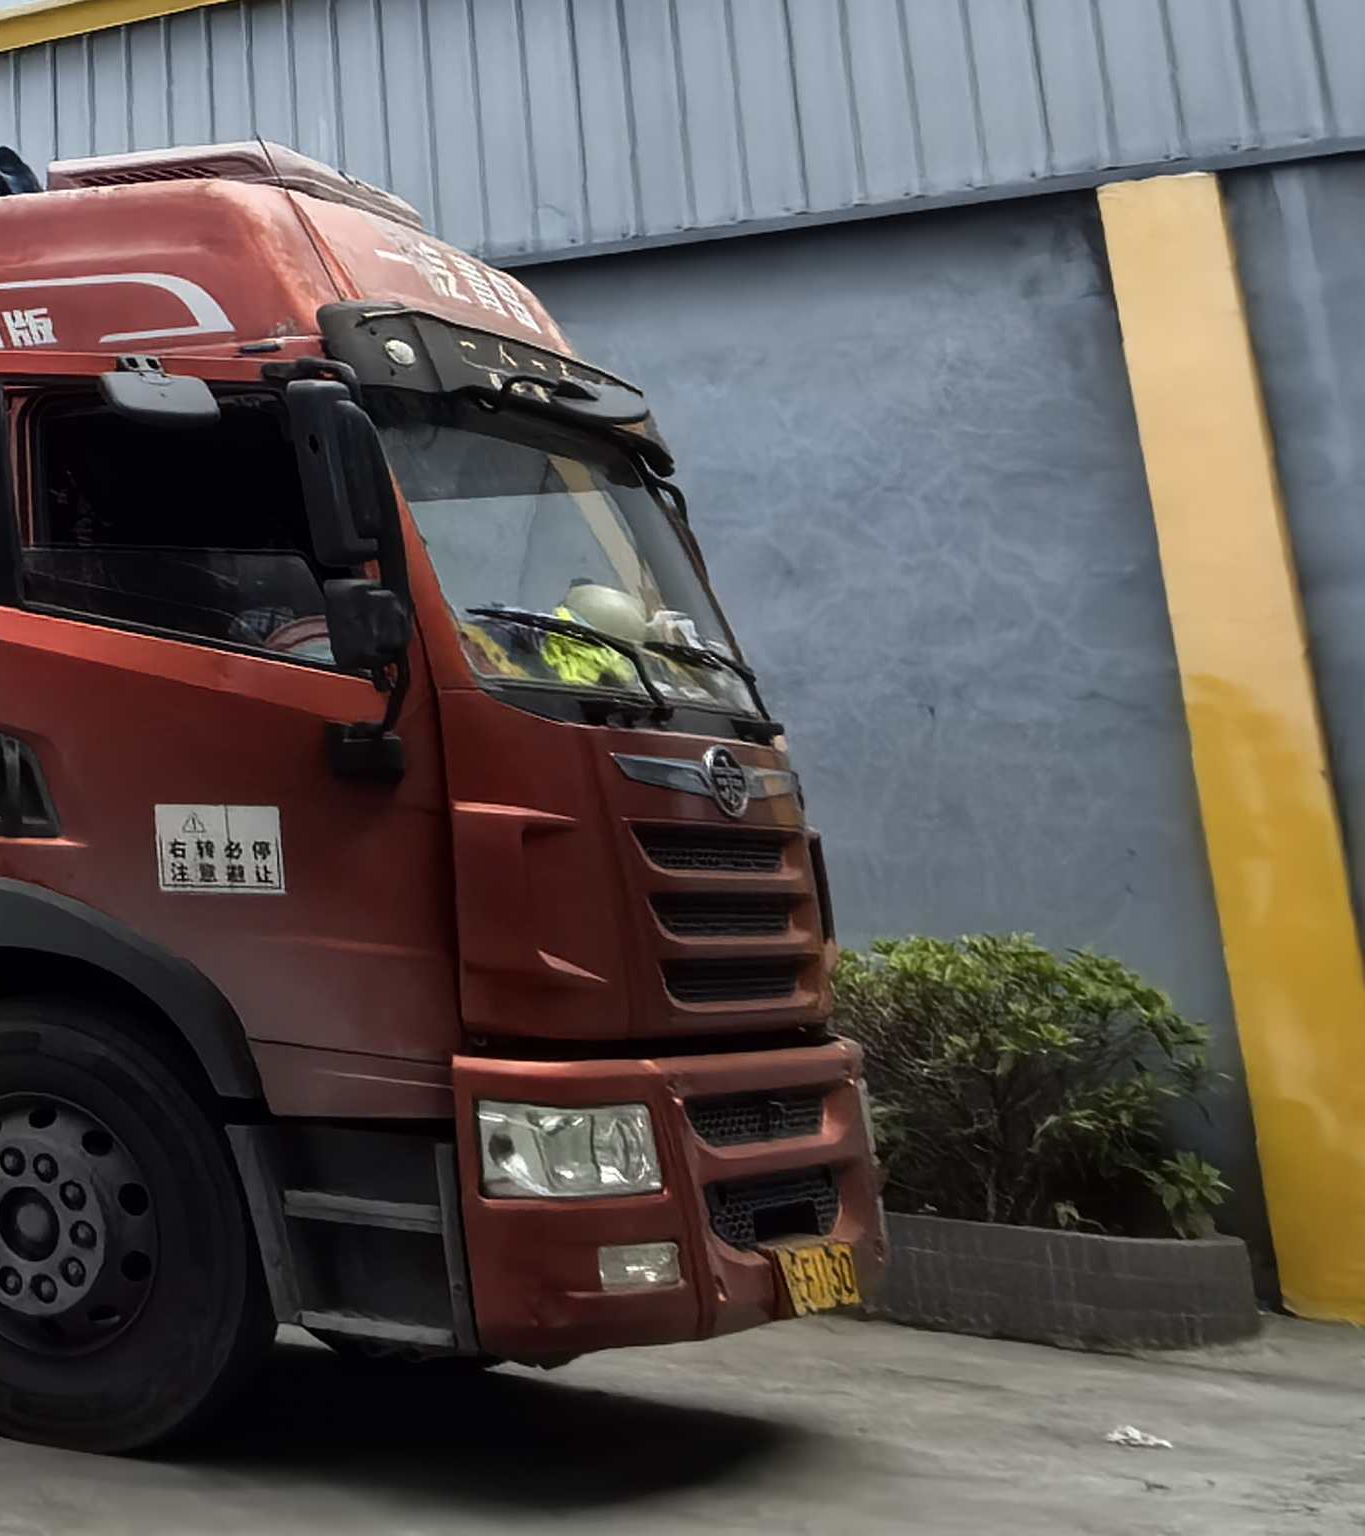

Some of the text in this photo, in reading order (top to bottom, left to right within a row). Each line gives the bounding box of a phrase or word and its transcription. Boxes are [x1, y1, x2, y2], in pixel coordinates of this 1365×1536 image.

[169, 839, 272, 860] 右转必停
[171, 863, 274, 884] 注意避让
